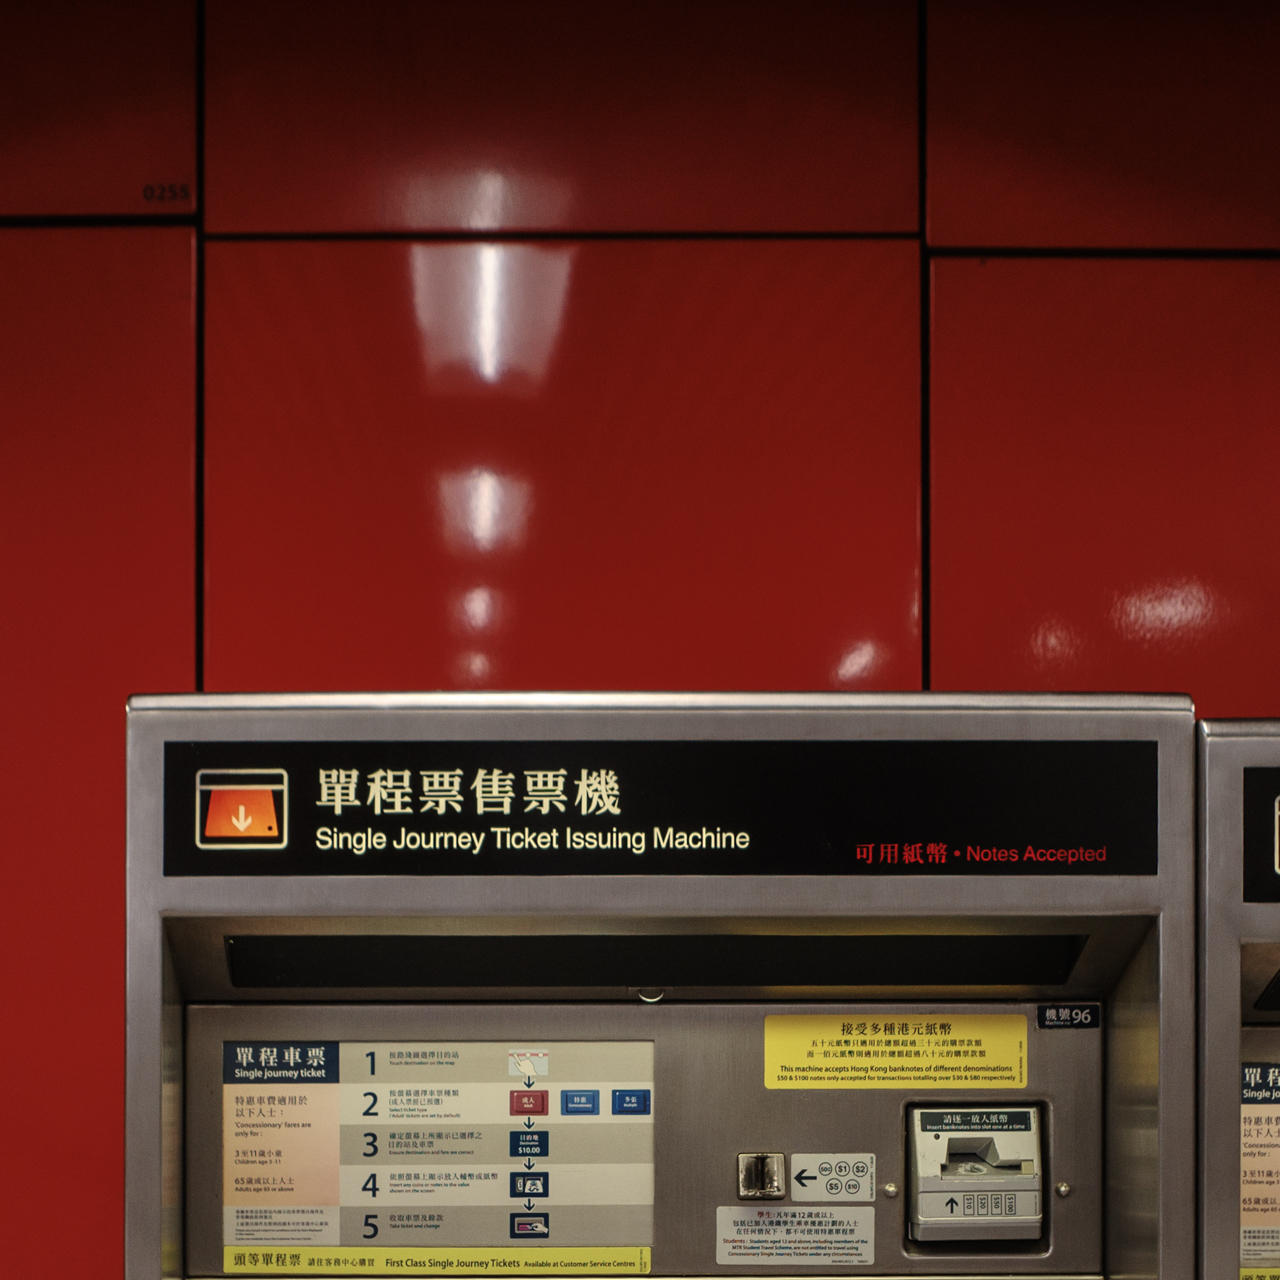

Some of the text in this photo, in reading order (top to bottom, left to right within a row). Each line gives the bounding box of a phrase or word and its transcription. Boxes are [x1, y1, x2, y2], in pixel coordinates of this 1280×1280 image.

[316, 768, 621, 815] 單程票售票機
[316, 827, 749, 854] Single Journey Ticket Issuing Machine
[856, 843, 1106, 864] 可用紙幣 Notes Accepted
[1072, 1009, 1091, 1023] 96
[841, 1022, 951, 1036] 接受多種港元紙幣
[235, 1047, 325, 1066] 單程車票
[365, 1052, 376, 1075] 1
[235, 1069, 325, 1079] Single journey ticket
[824, 1065, 849, 1074] accepts
[850, 1065, 868, 1074] Hong
[870, 1065, 887, 1074] Kong
[1243, 1089, 1270, 1099] Single
[363, 1092, 378, 1116] 2
[235, 1121, 283, 1130] 'Concessionary'
[363, 1133, 378, 1157] 3
[362, 1174, 379, 1197] 4
[363, 1215, 378, 1239] 5
[234, 1253, 301, 1266] 頭等單程票
[386, 1259, 520, 1269] First Class Single Journey Tickets
